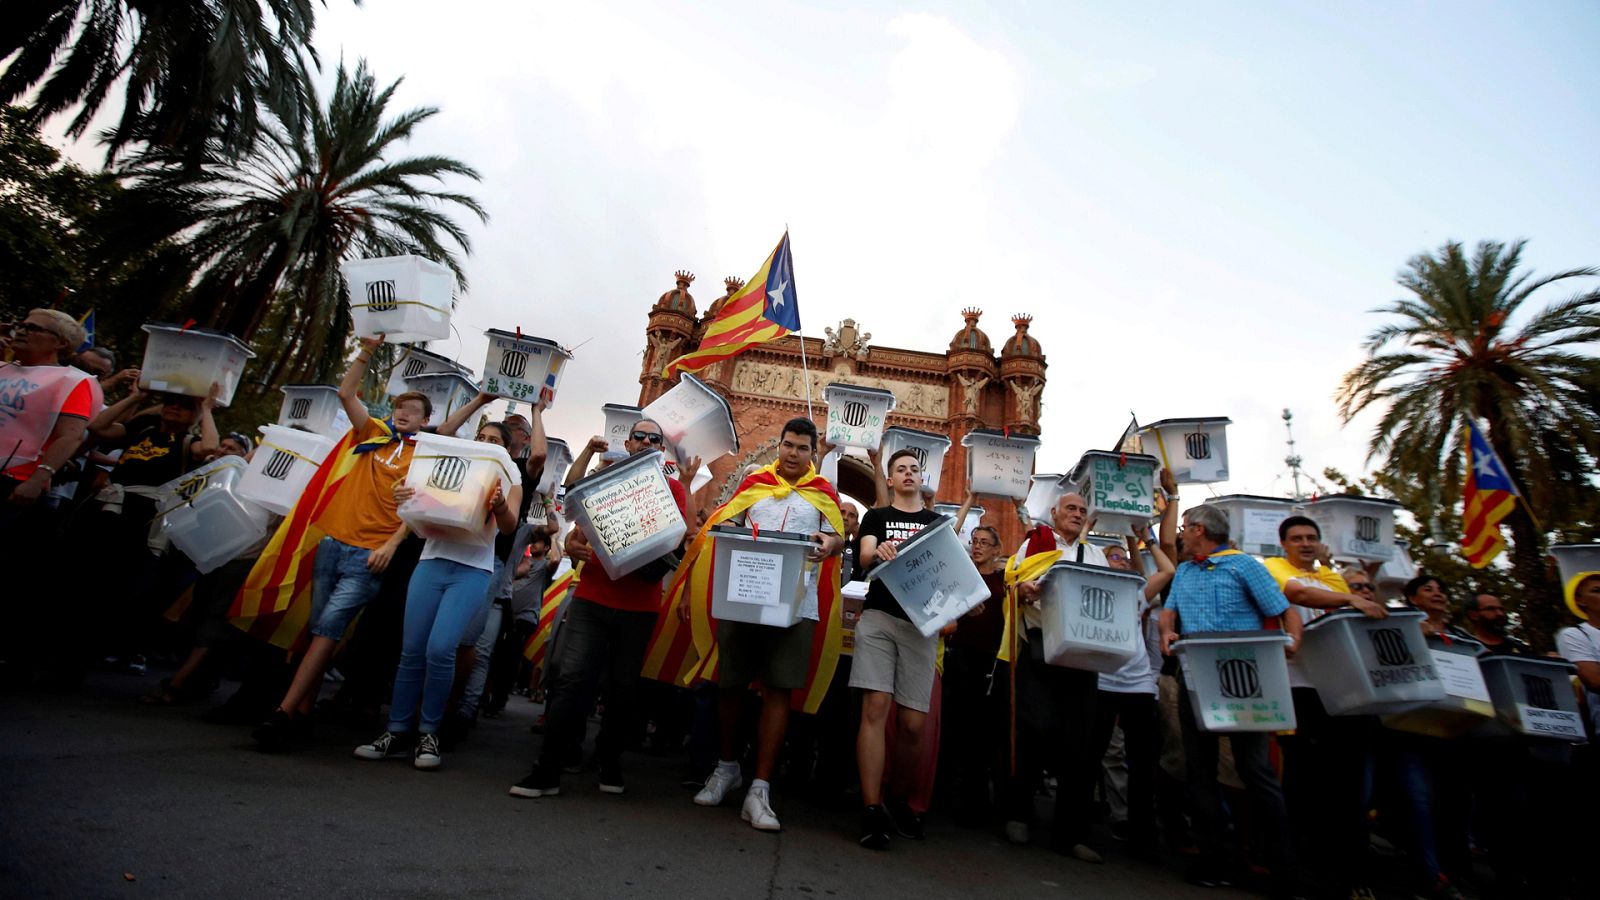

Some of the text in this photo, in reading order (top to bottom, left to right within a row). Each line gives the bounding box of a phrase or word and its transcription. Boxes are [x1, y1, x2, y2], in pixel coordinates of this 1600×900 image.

[496, 340, 542, 355] EL BISAURA
[487, 385, 527, 400] NO 69
[508, 381, 535, 395] 2358
[867, 414, 881, 428] NO
[1094, 459, 1107, 471] El
[1111, 471, 1128, 484] dit
[1095, 480, 1115, 493] a la
[1124, 476, 1148, 498] SÍ
[1094, 490, 1152, 513] República
[641, 517, 657, 531] 533
[885, 520, 929, 530] LLIBERTA
[905, 549, 934, 574] SANTA
[930, 576, 943, 590] DE
[1068, 622, 1130, 643] VILADRAU
[1526, 708, 1546, 718] SANT
